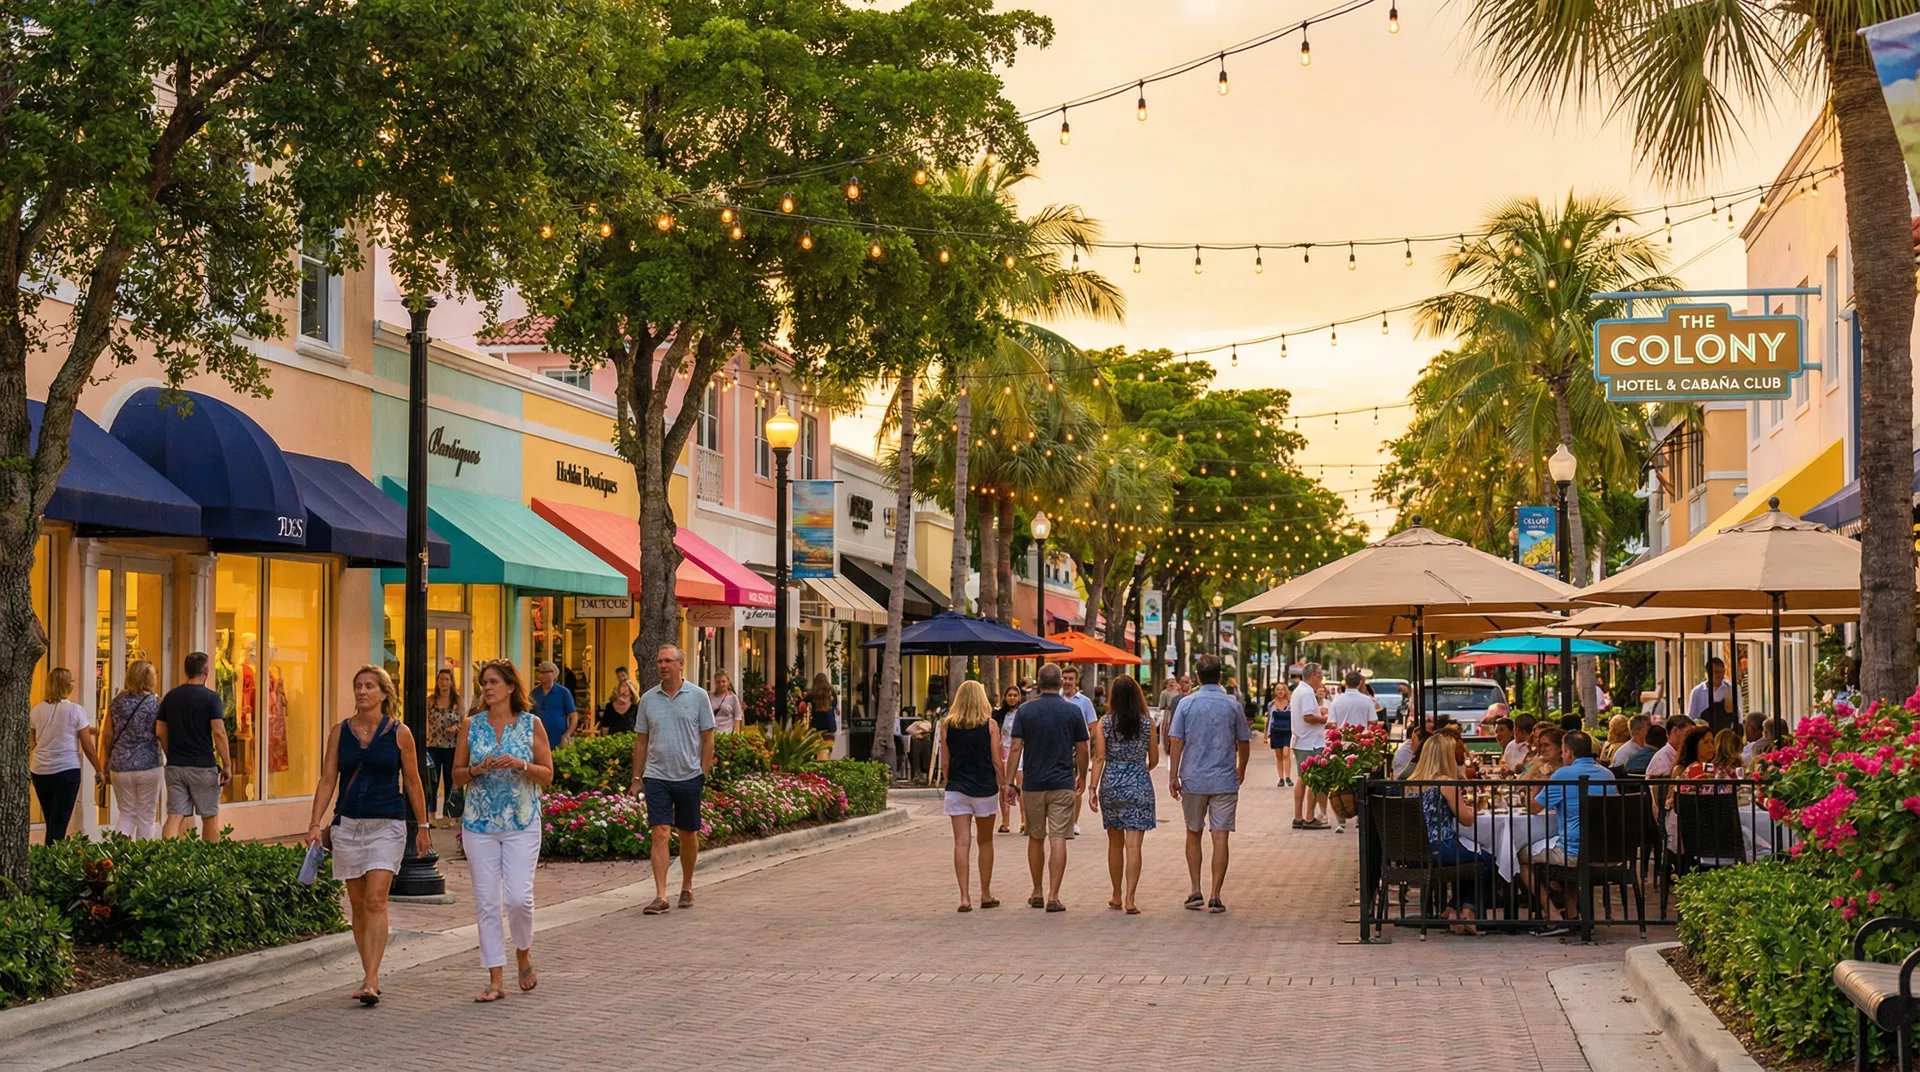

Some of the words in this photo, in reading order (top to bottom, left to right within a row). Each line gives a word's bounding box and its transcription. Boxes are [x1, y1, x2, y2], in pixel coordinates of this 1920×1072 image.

[1679, 315, 1715, 329] THE
[1610, 332, 1787, 367] COLONY
[1616, 379, 1662, 392] HOTEL
[1666, 378, 1676, 391] &
[1680, 375, 1740, 390] CABAÑA
[1743, 376, 1781, 389] CLUB
